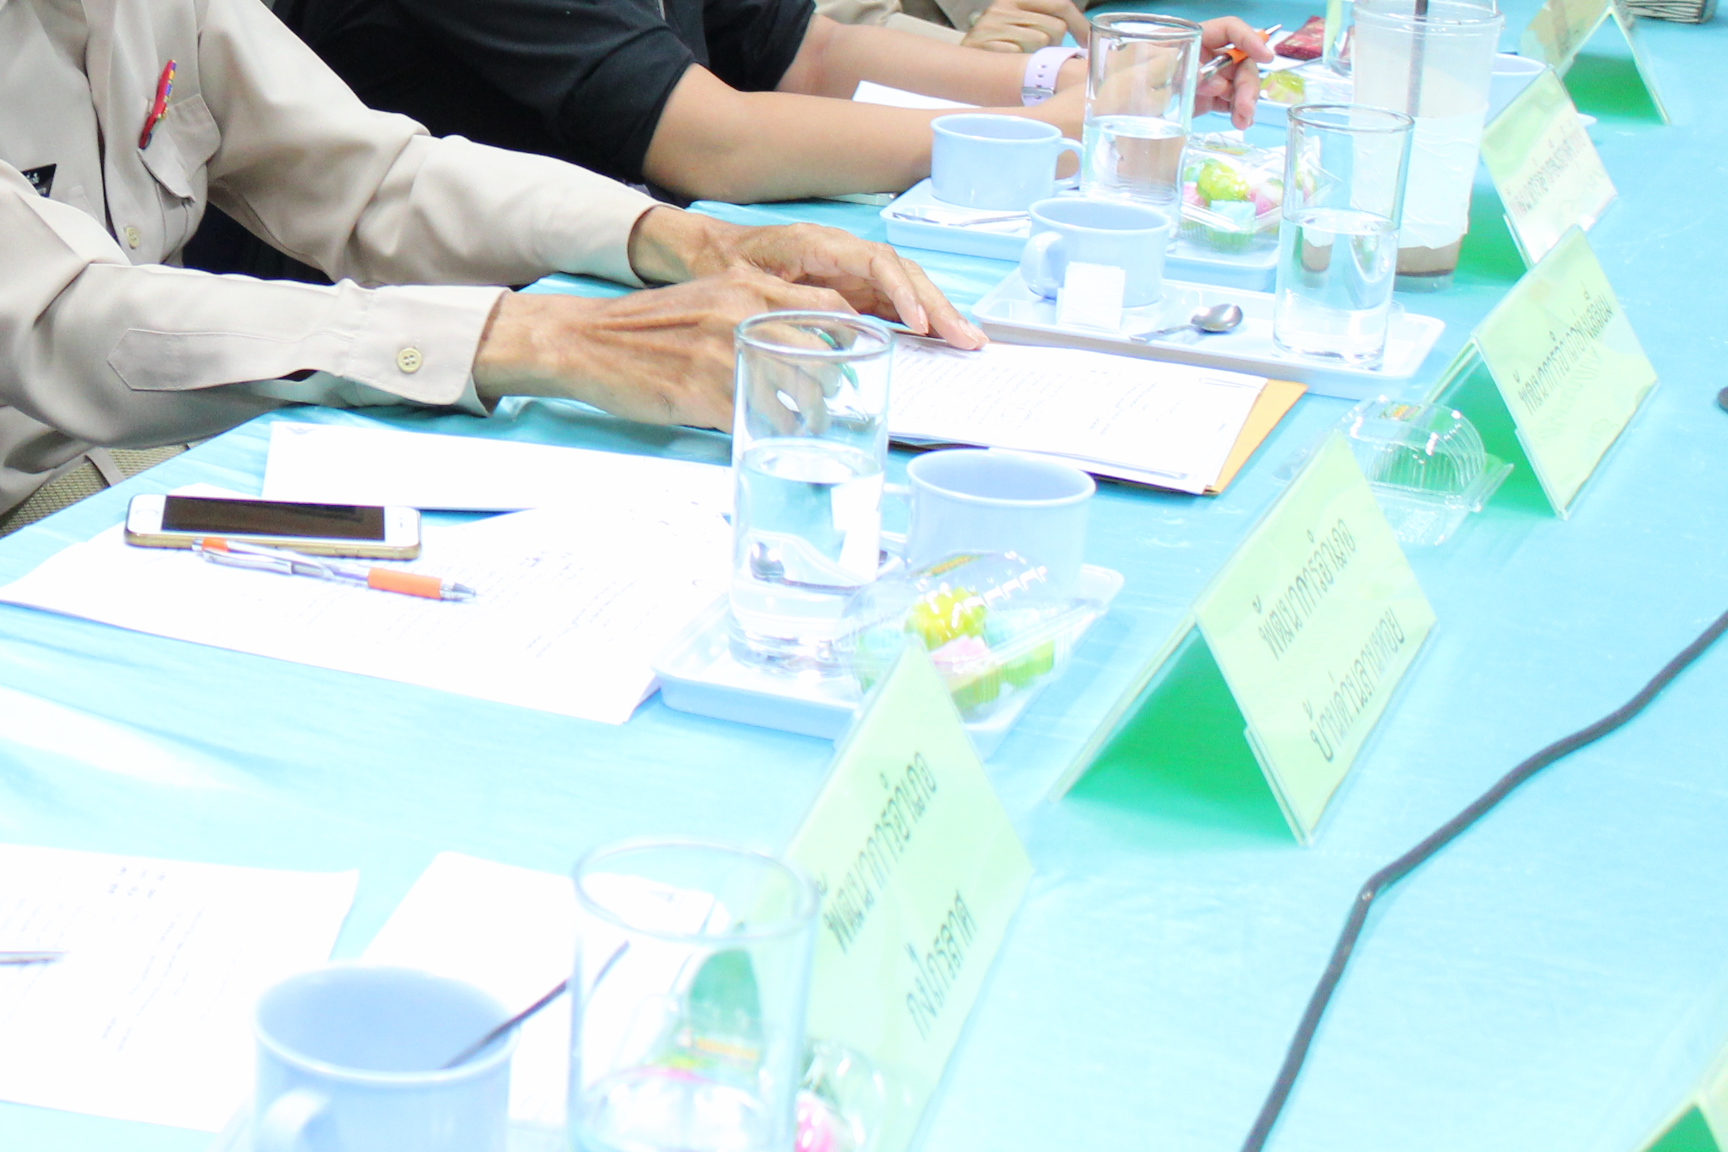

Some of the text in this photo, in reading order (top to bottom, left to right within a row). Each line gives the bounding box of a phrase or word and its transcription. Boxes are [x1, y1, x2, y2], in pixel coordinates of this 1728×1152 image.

[1252, 517, 1358, 661] พัฒนาการอำเภอ
[1302, 607, 1406, 763] บ้านด่านลานหอย
[818, 750, 938, 954] พัฒนาการอำเภอ
[904, 889, 978, 1041] กงไกรลาศ
